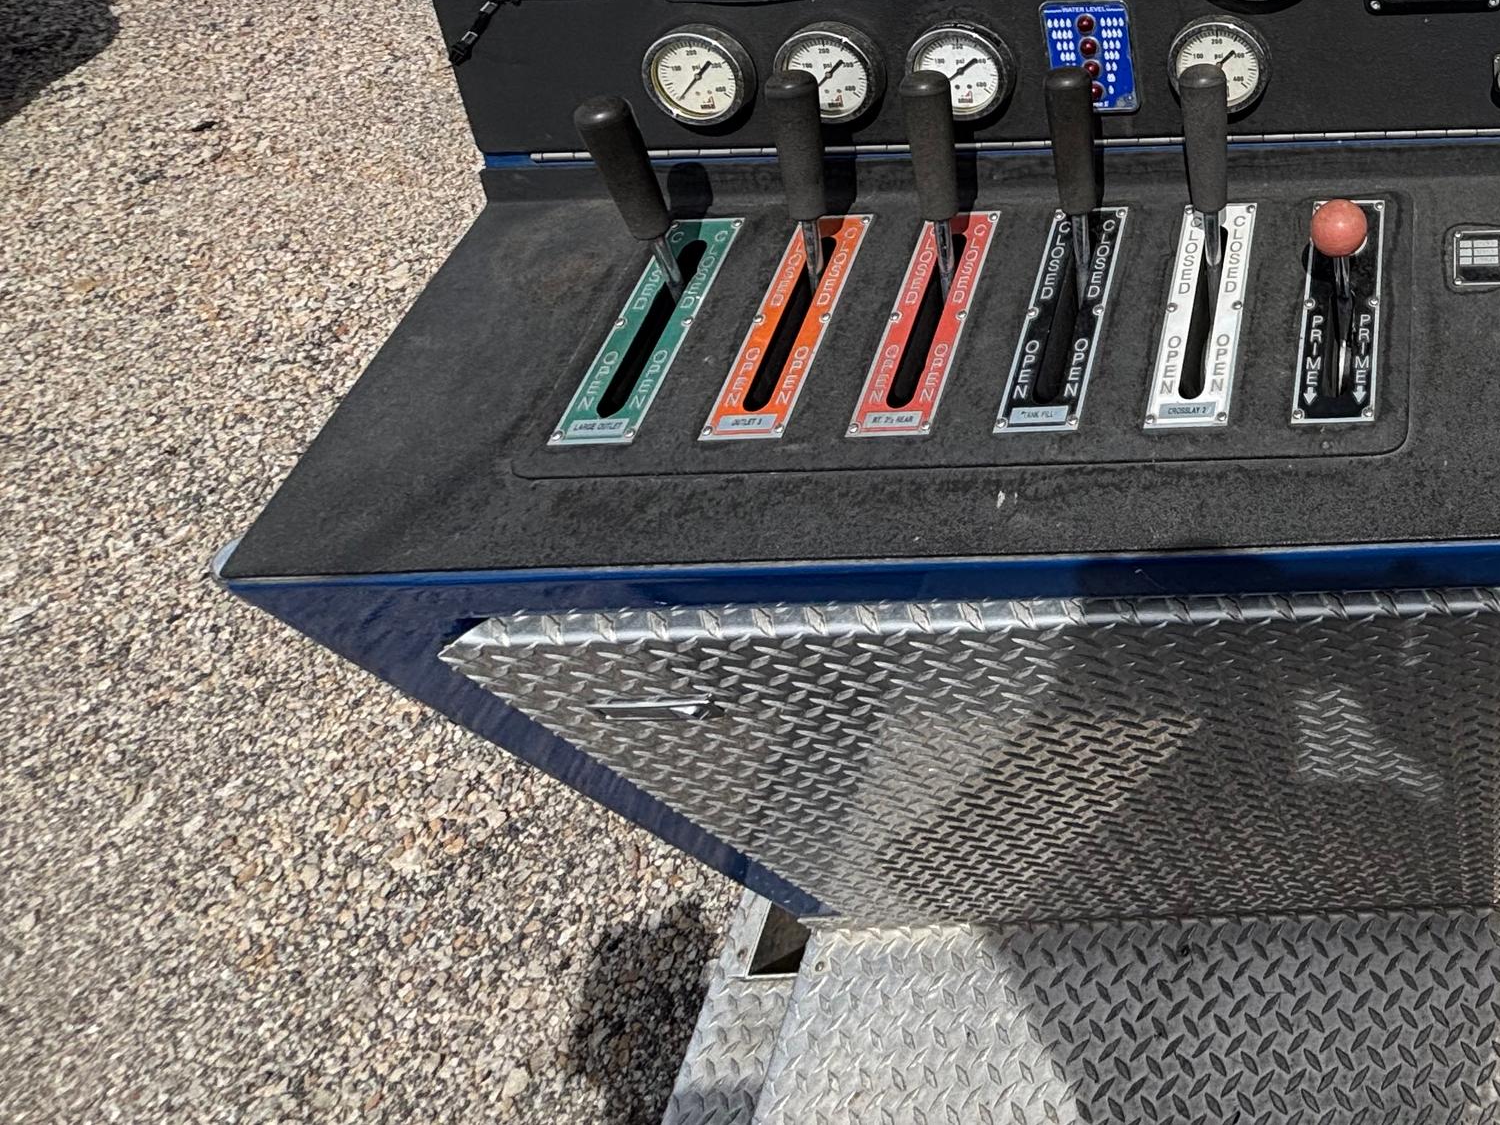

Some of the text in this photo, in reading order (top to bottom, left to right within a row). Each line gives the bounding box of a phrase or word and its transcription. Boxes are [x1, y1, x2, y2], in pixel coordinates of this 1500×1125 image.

[686, 49, 697, 57] 200
[691, 63, 701, 72] psi
[818, 47, 830, 55] 200
[823, 61, 833, 70] psi
[1214, 52, 1224, 60] psi
[680, 231, 729, 309] CLOSED
[816, 227, 858, 306] CLOSED
[952, 223, 987, 304] CLOSED
[1040, 221, 1072, 300] CLOSED
[1087, 219, 1116, 298] CLOSED
[1178, 216, 1203, 295] CLOSED
[1224, 215, 1248, 293] CLOSED
[629, 349, 668, 409] OPEN
[725, 347, 761, 408] OPEN
[775, 346, 810, 405] OPEN
[868, 343, 900, 404] OPEN
[919, 342, 949, 403] OPEN
[1012, 339, 1040, 399] OPEN
[1063, 337, 1089, 397] OPEN
[1159, 335, 1182, 395] OPEN
[1210, 333, 1230, 393] OPEN
[1305, 315, 1324, 386] PRIME
[1354, 314, 1371, 385] PRIME
[577, 350, 618, 411] OPEN
[1167, 406, 1200, 415] CROSSLAY
